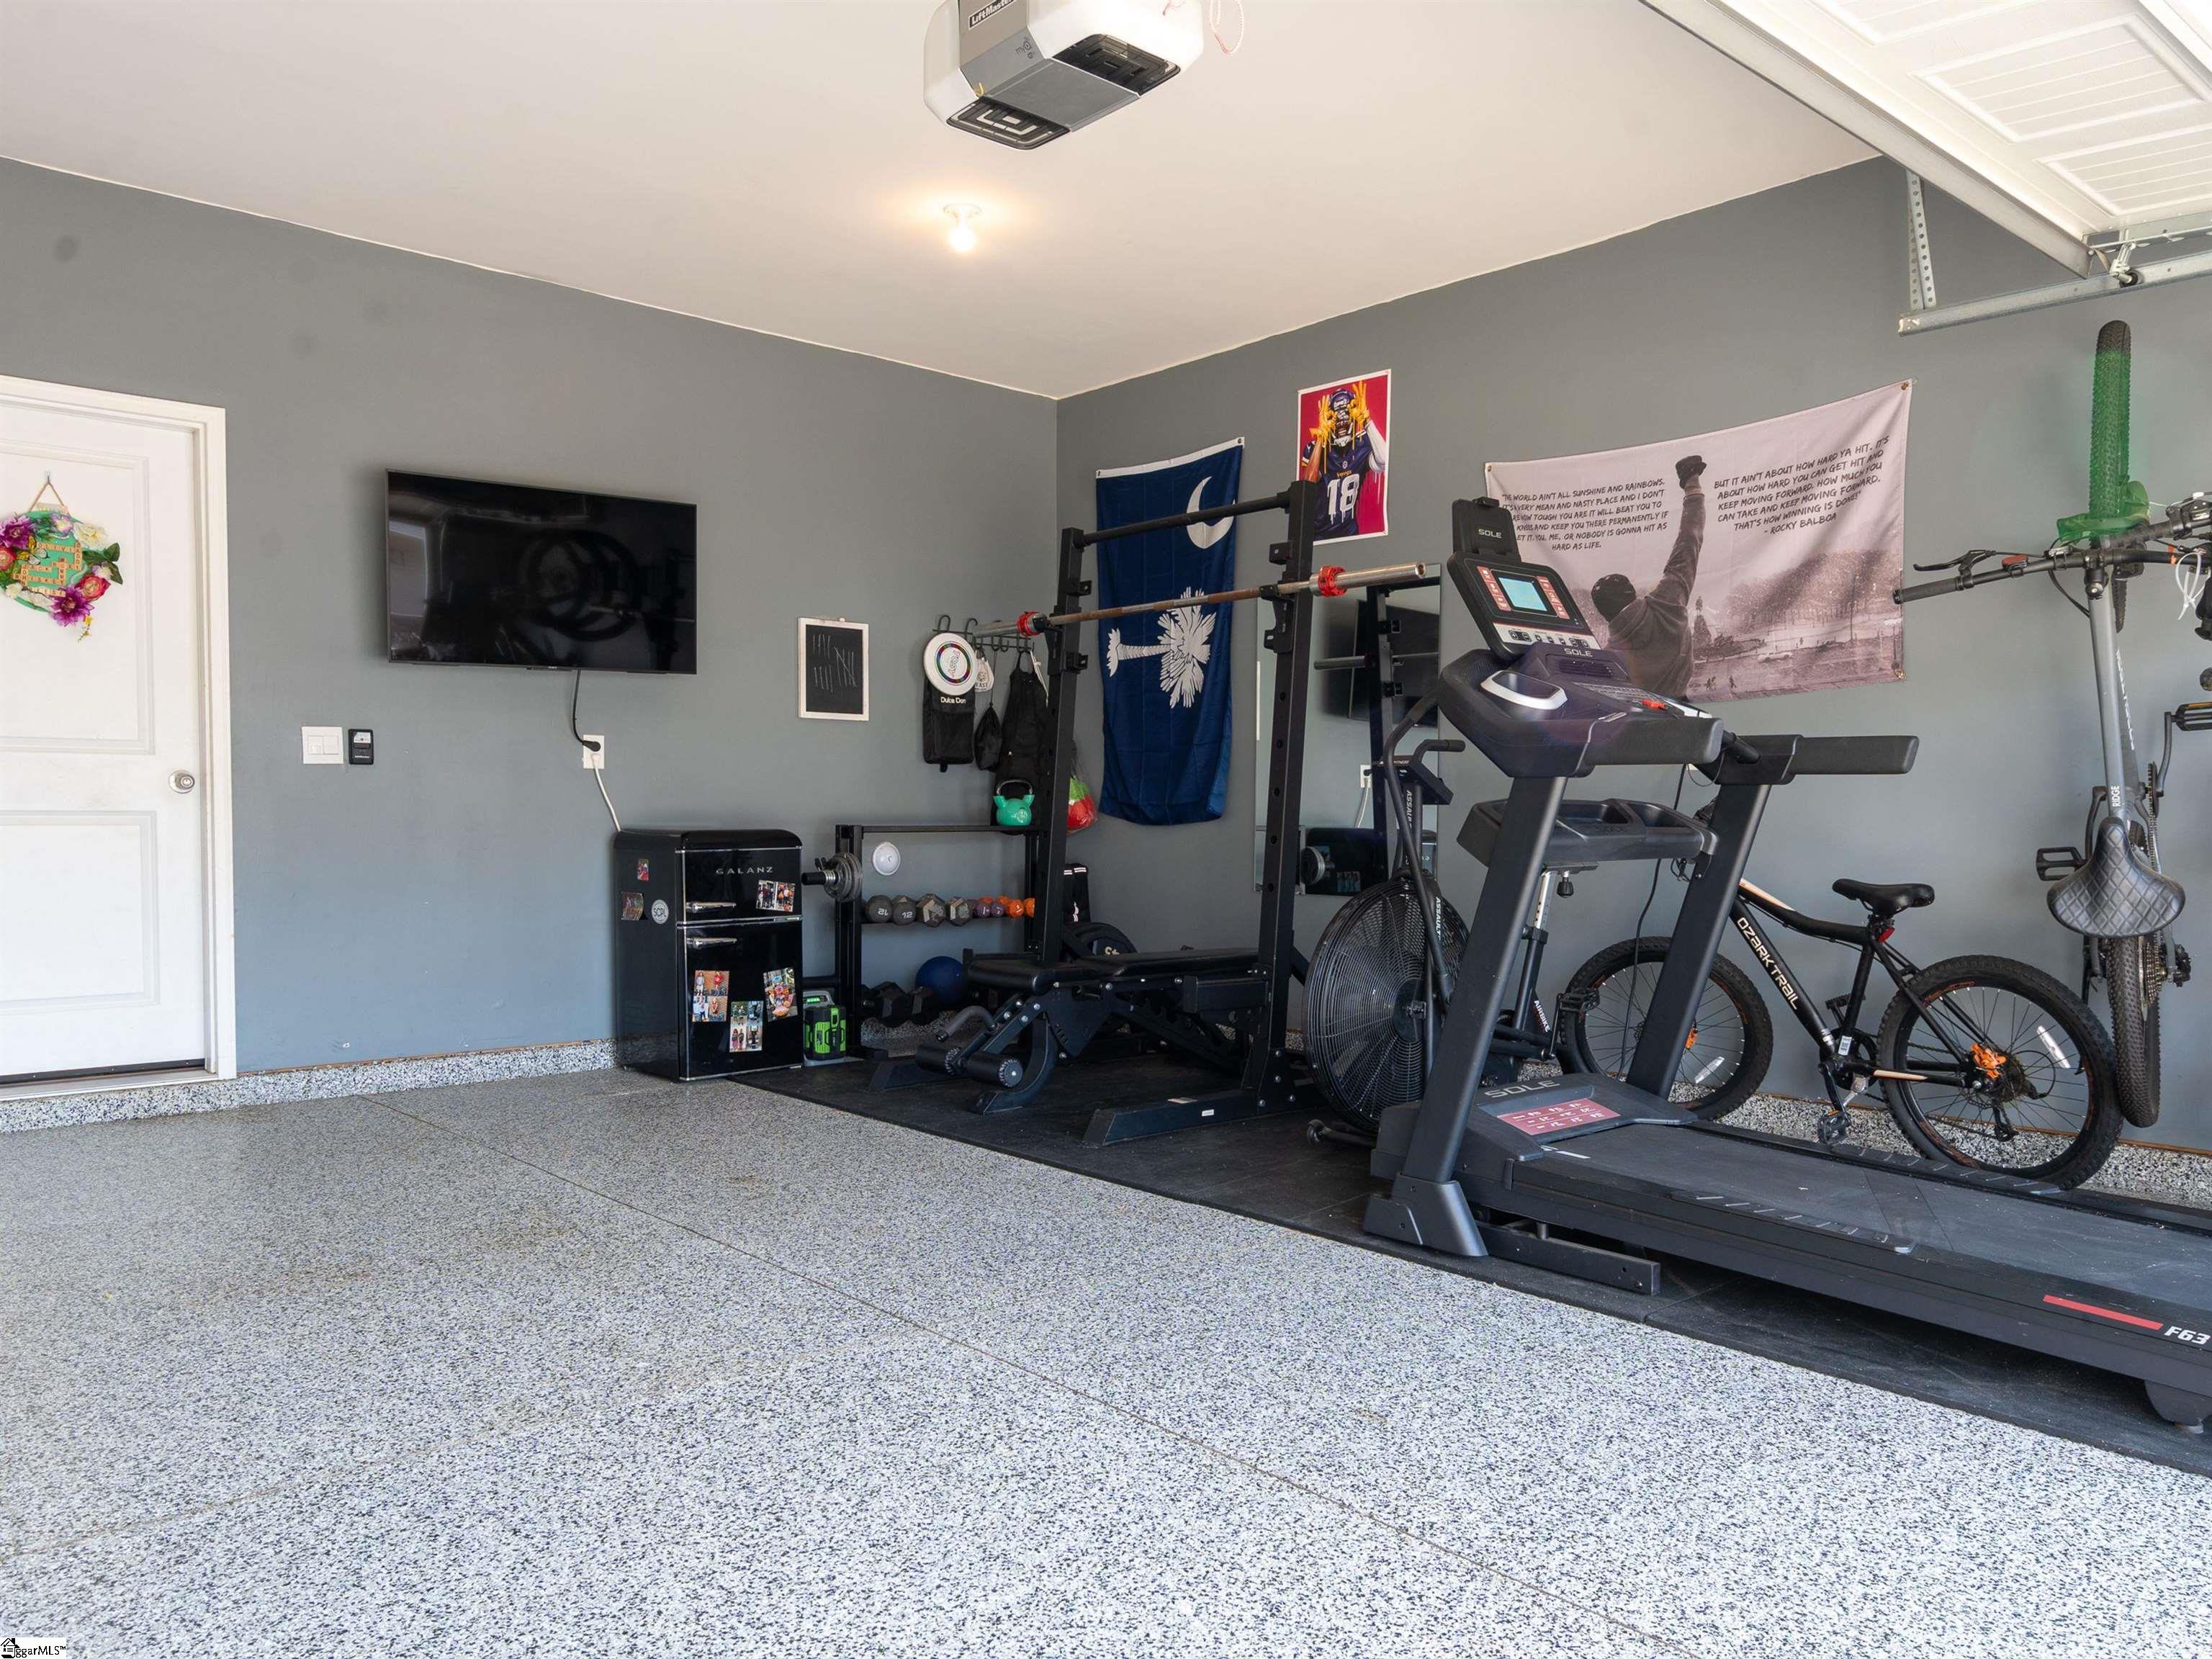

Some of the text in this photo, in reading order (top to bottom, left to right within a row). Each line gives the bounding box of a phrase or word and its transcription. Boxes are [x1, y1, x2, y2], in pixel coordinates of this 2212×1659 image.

[972, 0, 1012, 24] LiftMaste
[1714, 436, 1889, 489] BUT IT AIN'T ABOUT HOW HARD YA HIT. IT'S
[1717, 449, 1884, 500] ABOUT HOW HARD YOU CAN GET HIT AND
[1327, 473, 1359, 518] 18
[1539, 493, 1557, 501] AIN'T
[1573, 487, 1606, 497] SUNSHINE
[1607, 485, 1623, 493] AND
[1625, 478, 1665, 491] RAINBOWS.
[1718, 462, 1882, 511] KEEP MOVING FORWARD. HOW MUCH YOU
[1573, 499, 1594, 508] NASTY
[1596, 496, 1619, 505] PLACE
[1620, 494, 1635, 503] AND
[1642, 490, 1665, 499] DON'T
[1718, 475, 1881, 522] CAN TAKE AND KEEP MOVING FORWARD.
[1574, 511, 1588, 519] ARE
[1616, 505, 1635, 514] BEAT
[1586, 518, 1607, 527] THERE
[1609, 512, 1660, 525] PERMANENTLY
[1734, 518, 1762, 531] THAT'S
[1763, 513, 1781, 524] HOW
[1783, 504, 1821, 520] WINNING
[1824, 501, 1833, 511] IS
[1478, 529, 1502, 539] SOLE
[1576, 530, 1606, 539] NOBODY
[1616, 526, 1642, 536] GONNA
[1770, 521, 1797, 534] ROCKY
[1800, 513, 1837, 528] BALBOA
[1564, 648, 1593, 657] SOLE
[2110, 786, 2121, 807] RIDGE
[1534, 1000, 1550, 1033] AIRBIKE
[1484, 1080, 1560, 1098] SOLE
[2164, 1326, 2211, 1345] F63
